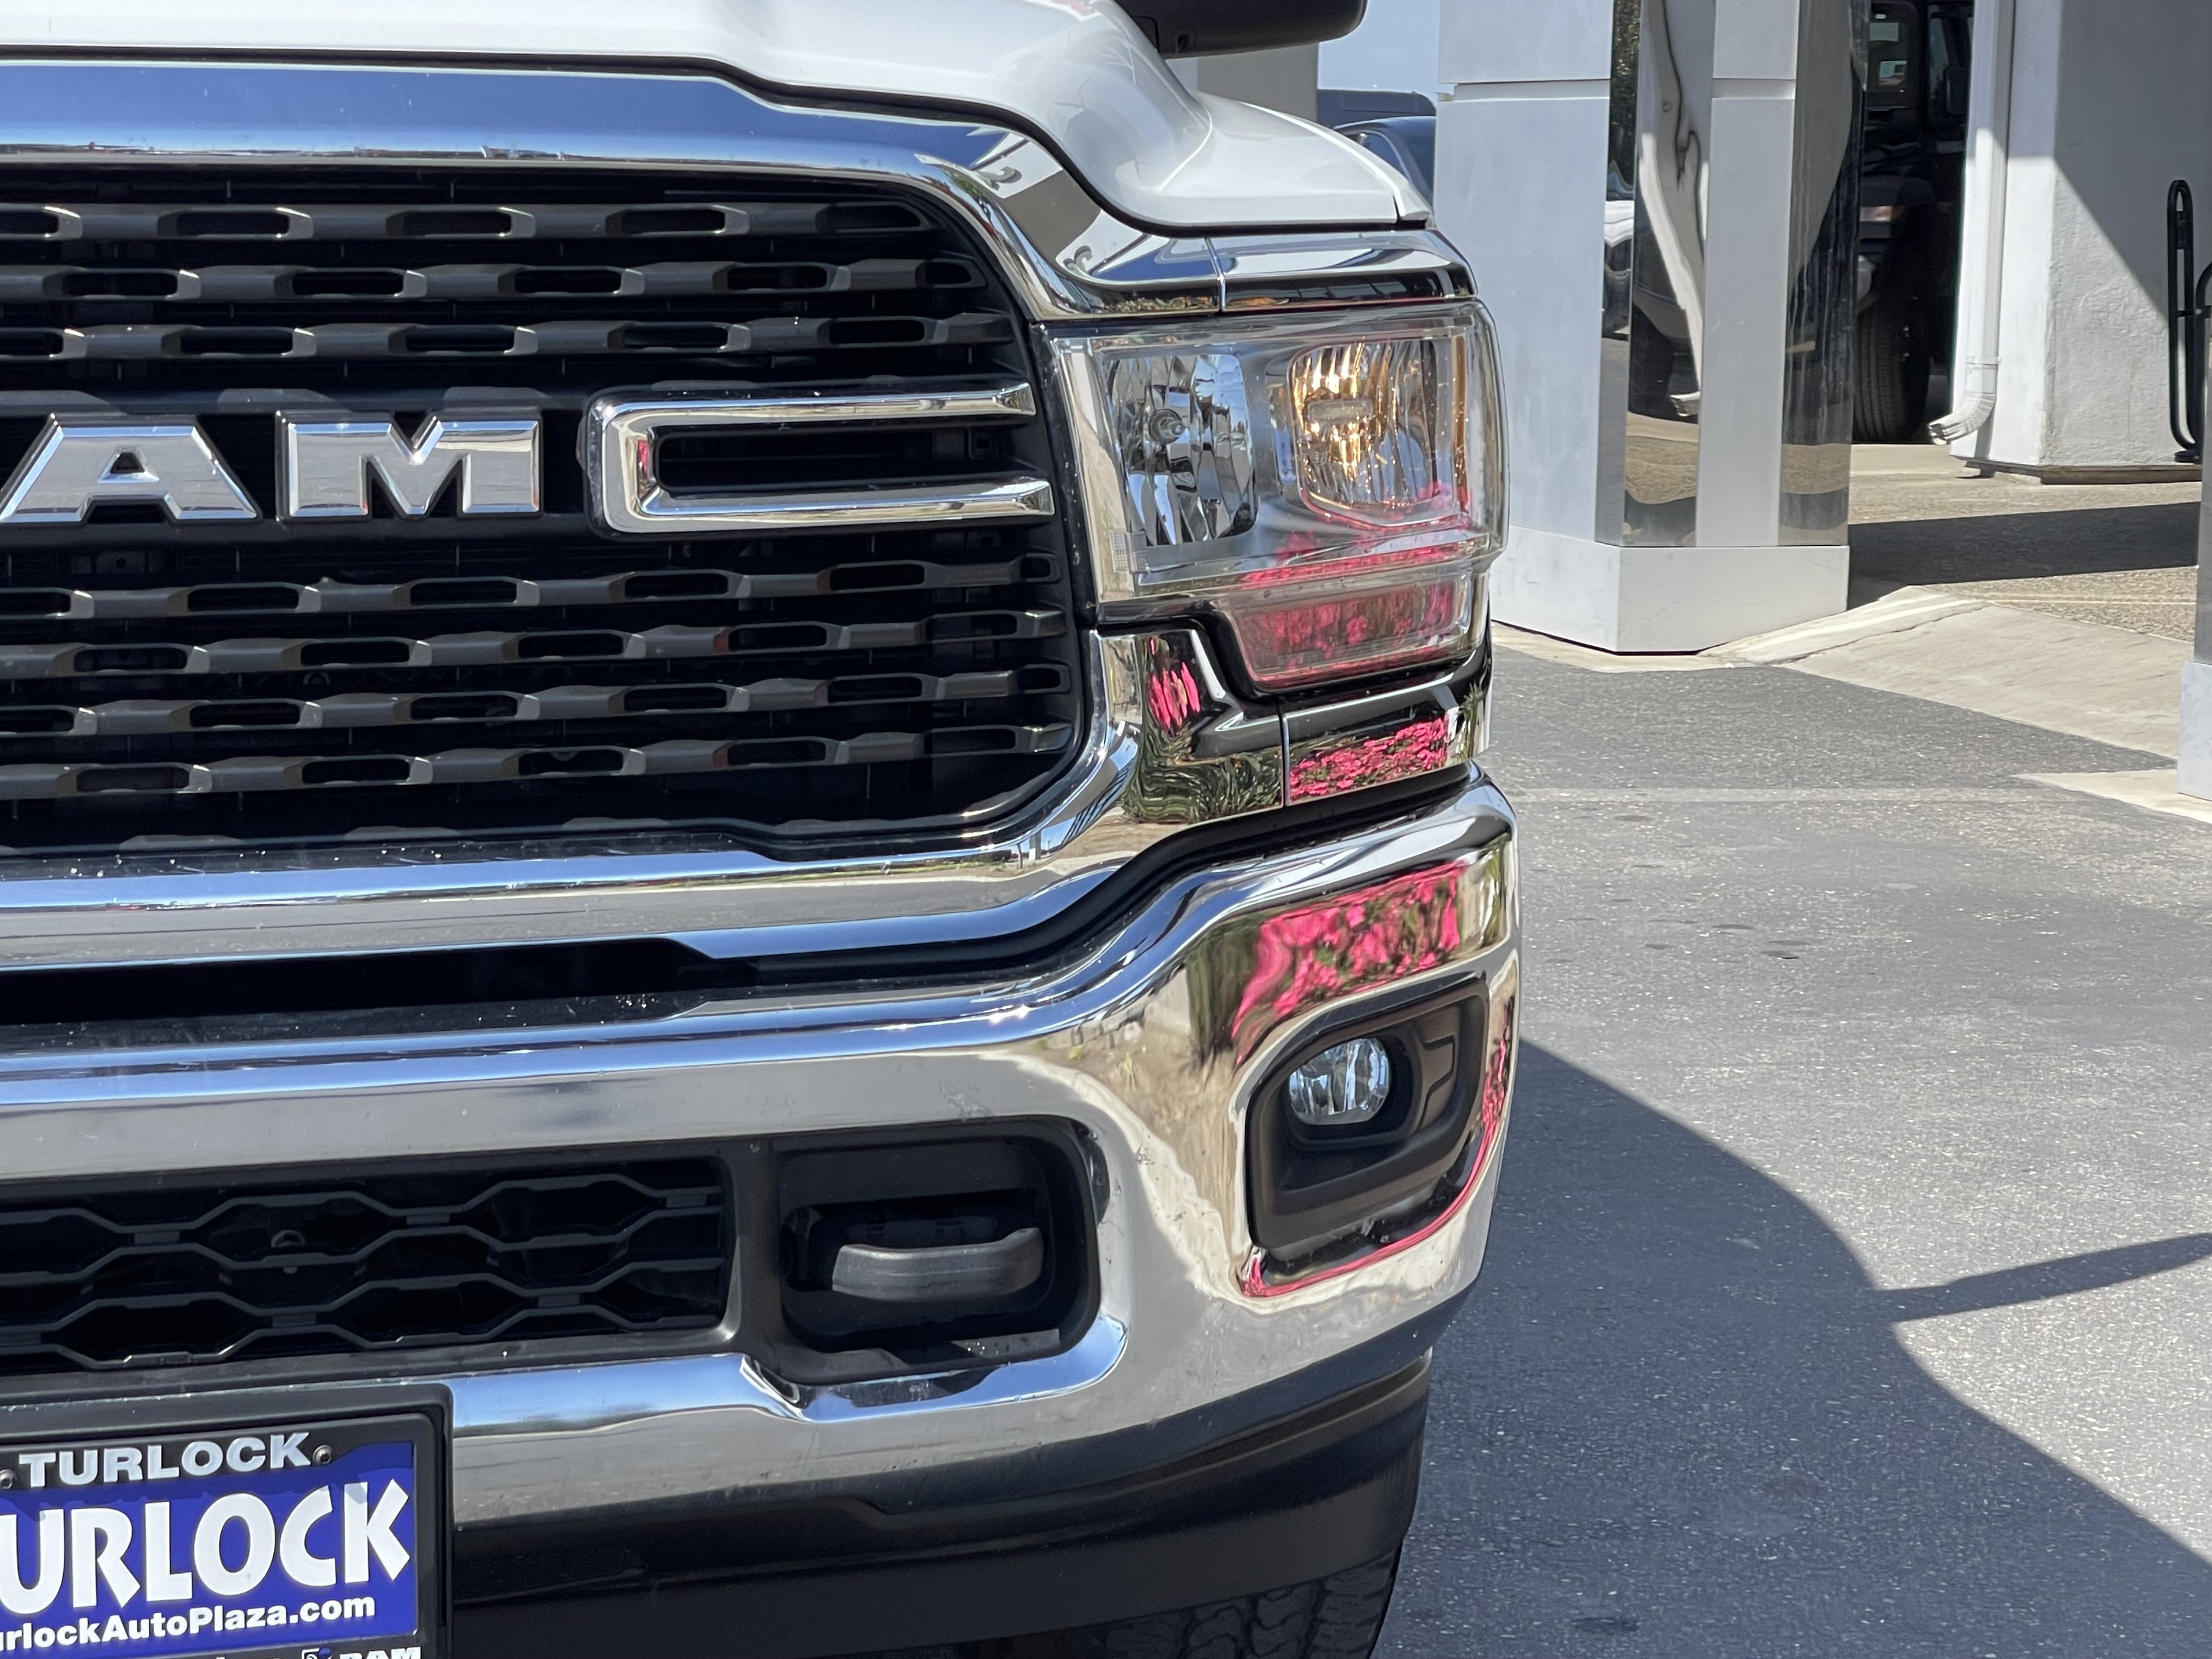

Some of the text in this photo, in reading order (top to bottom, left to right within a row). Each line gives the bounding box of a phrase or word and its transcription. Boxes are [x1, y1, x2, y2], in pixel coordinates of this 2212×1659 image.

[0, 413, 542, 523] AM
[19, 1432, 311, 1487] TURLOCK
[0, 1480, 410, 1614] URLOCK
[0, 1597, 375, 1651] rlockAutoPlaza.com
